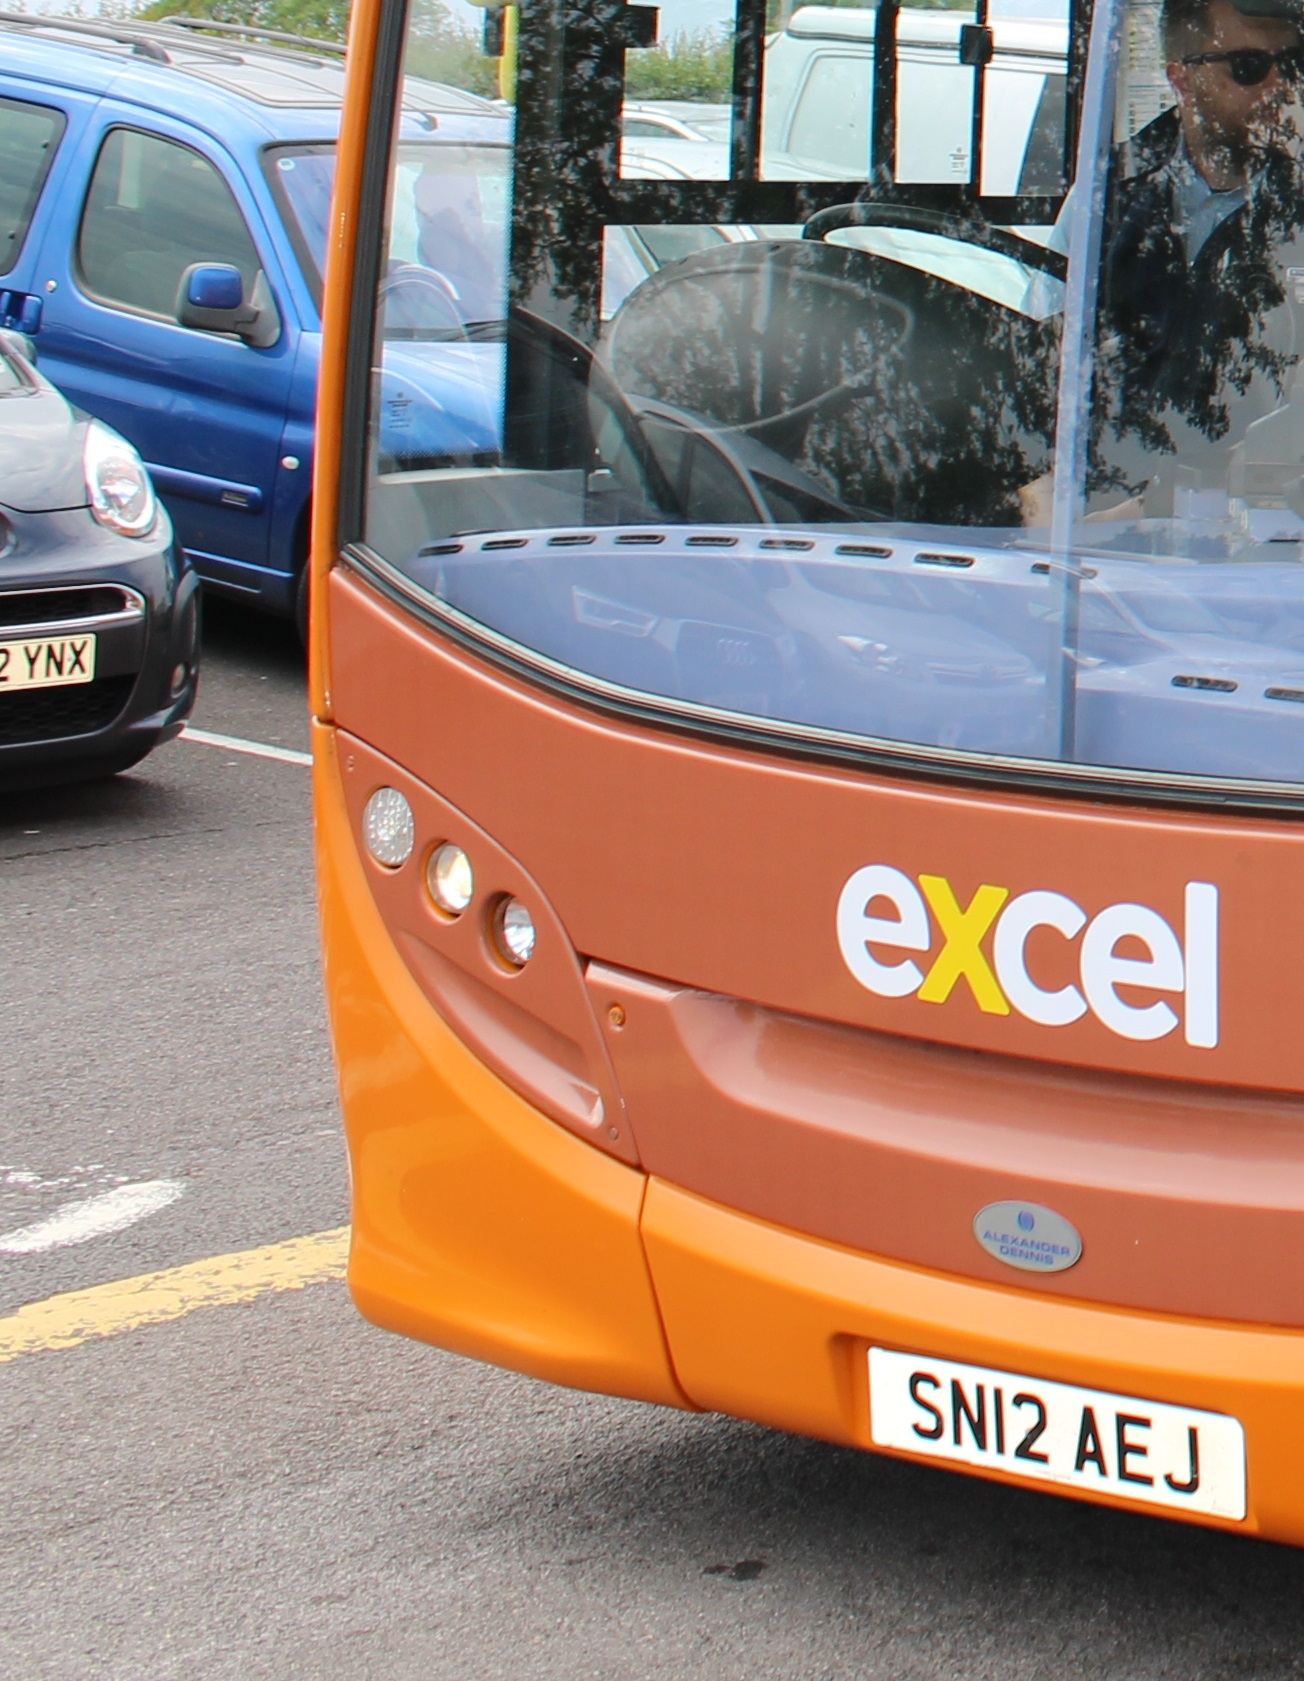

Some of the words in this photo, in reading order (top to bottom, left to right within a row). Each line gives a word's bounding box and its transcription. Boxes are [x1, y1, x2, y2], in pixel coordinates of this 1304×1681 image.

[24, 640, 88, 680] YNX
[836, 863, 1219, 1049] excel
[983, 1230, 1070, 1256] ALEXANDER
[1000, 1245, 1054, 1265] DENNIS
[907, 1371, 1050, 1464] SN12
[1074, 1406, 1200, 1494] AEJ
